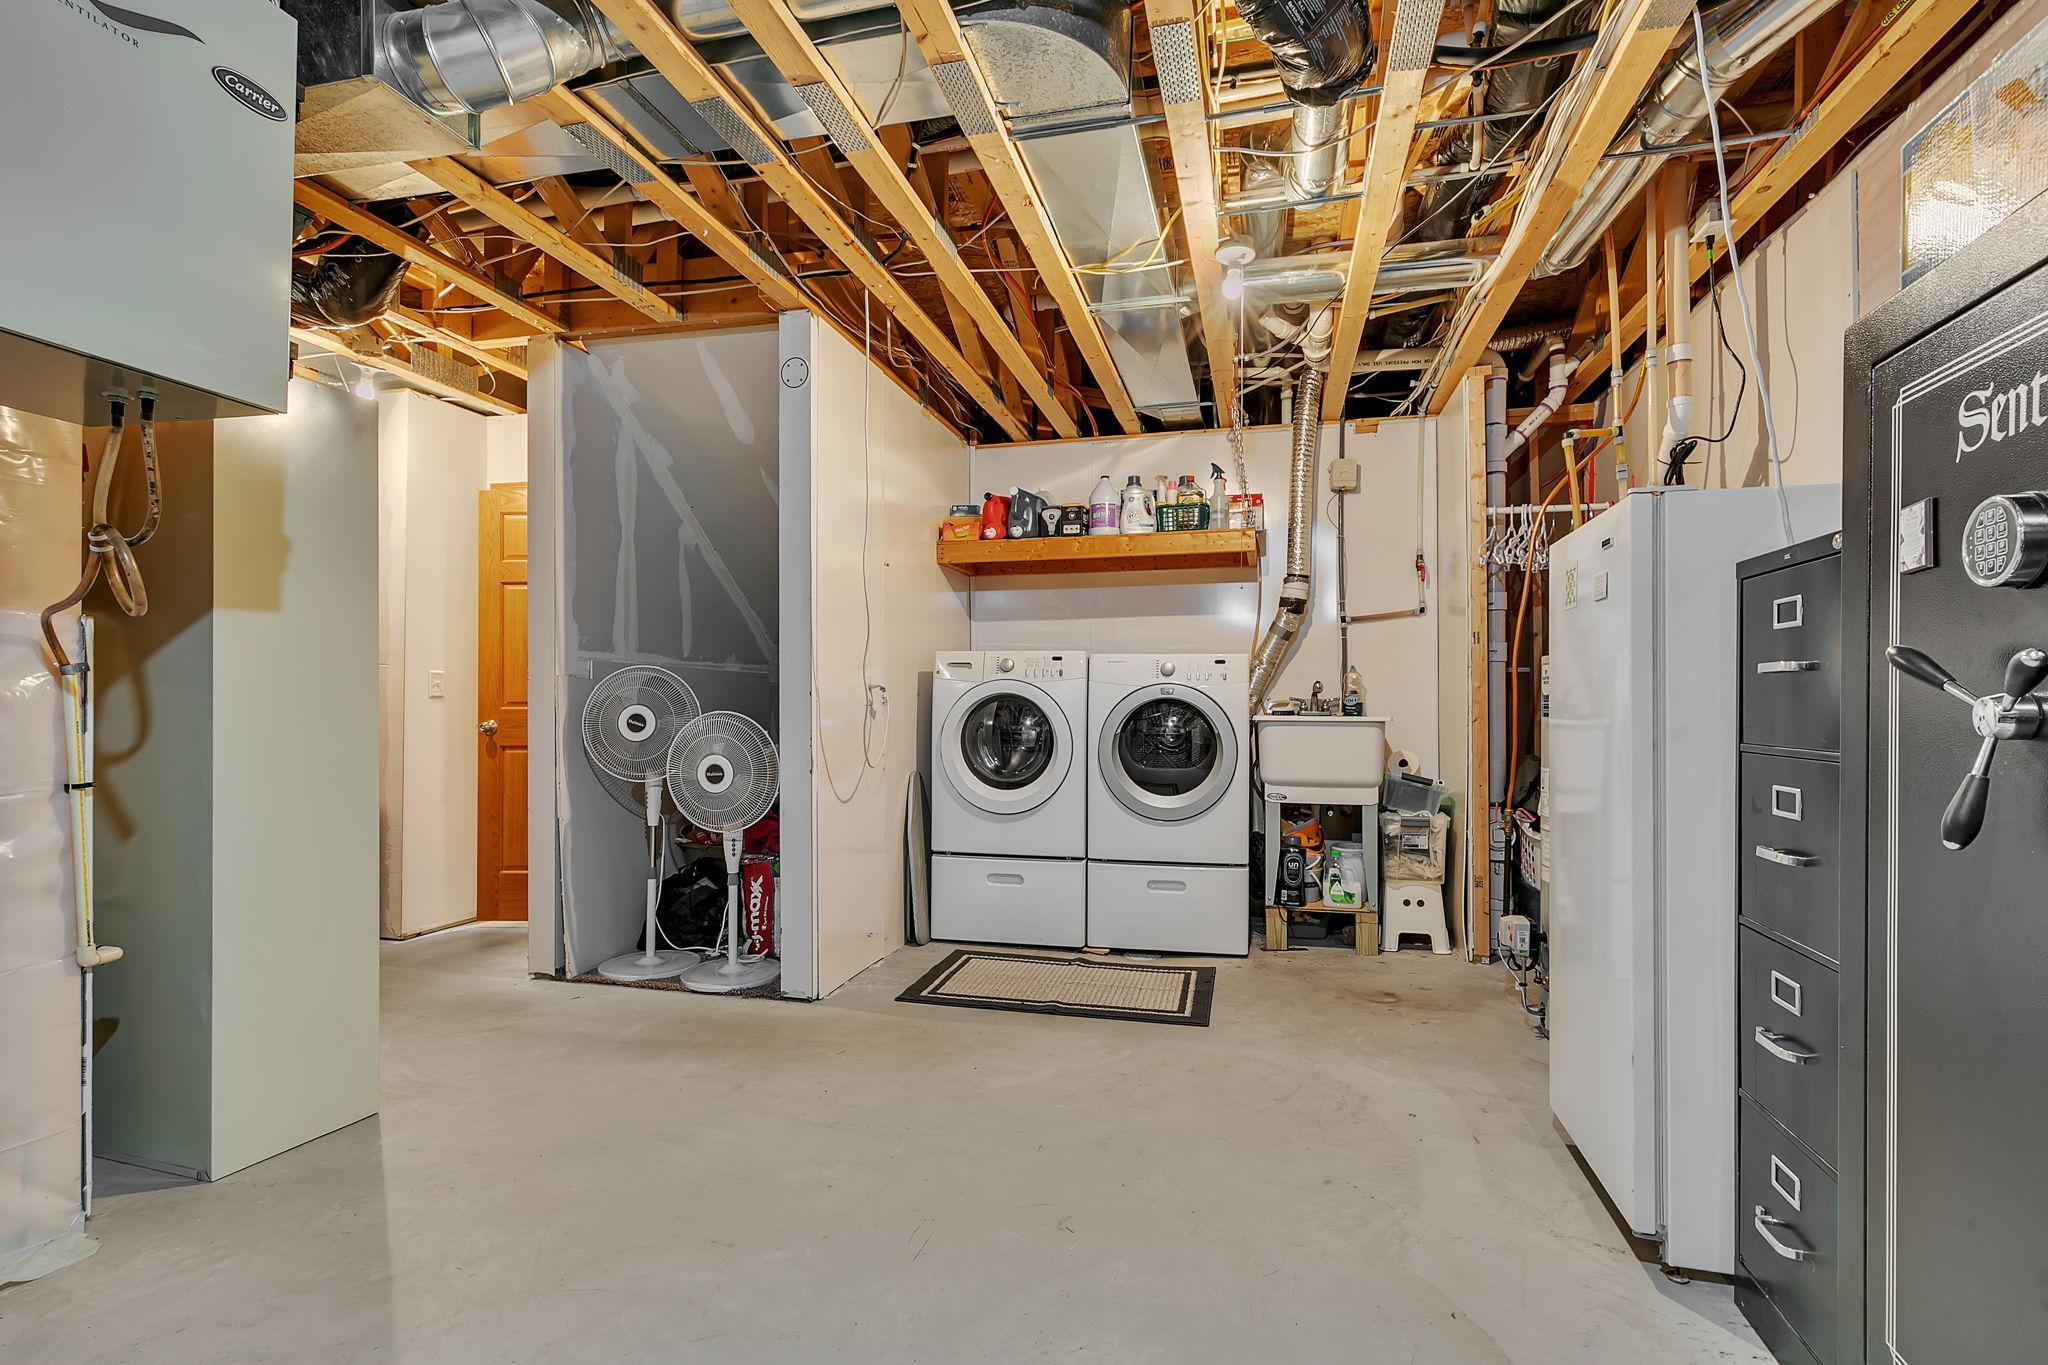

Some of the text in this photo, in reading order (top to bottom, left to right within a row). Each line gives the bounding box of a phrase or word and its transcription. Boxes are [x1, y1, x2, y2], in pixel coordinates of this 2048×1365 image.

[57, 0, 140, 48] NTILATOR
[1882, 10, 1895, 24] GAS
[224, 75, 279, 113] Carrier
